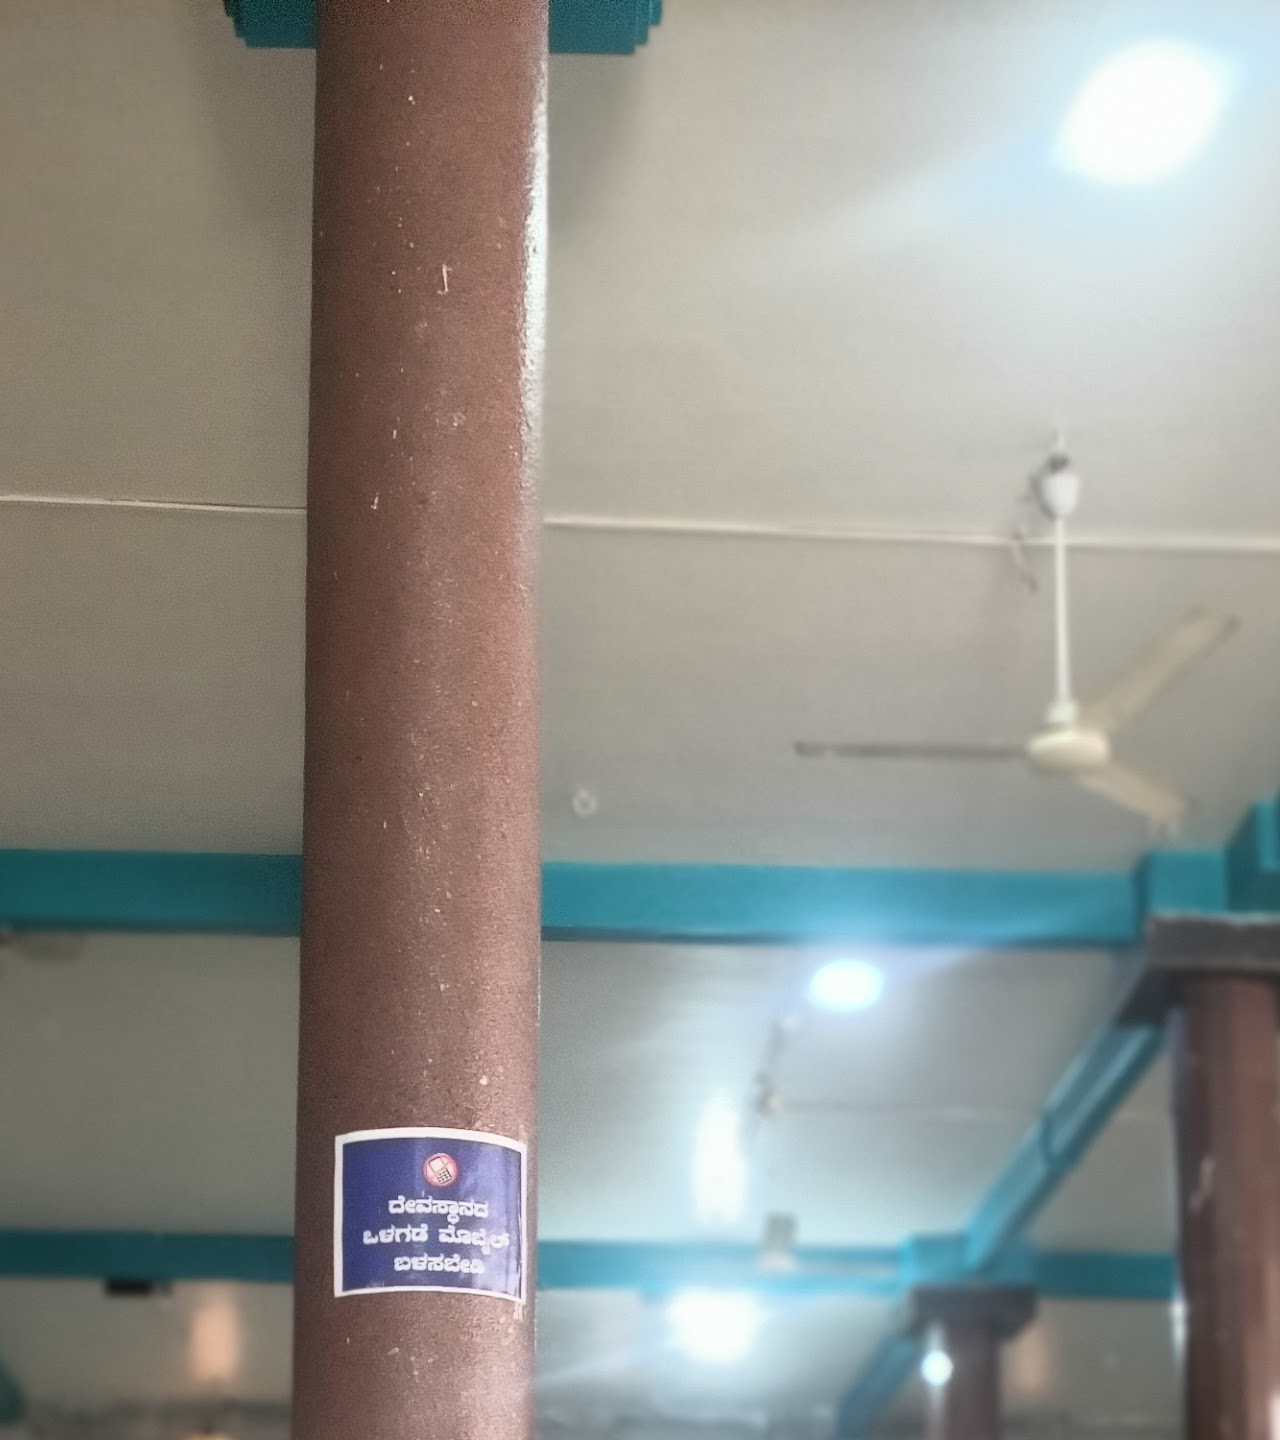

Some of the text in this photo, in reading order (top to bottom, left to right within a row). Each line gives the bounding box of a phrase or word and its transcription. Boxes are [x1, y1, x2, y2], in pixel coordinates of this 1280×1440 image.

[388, 1195, 489, 1224] ದೇವಸ್ಥಾನದ
[363, 1223, 510, 1255] ಒಳಗಡೆ ಮೊಬೈಲ್
[394, 1253, 485, 1274] ಬಳಸಬೇಡಿ
